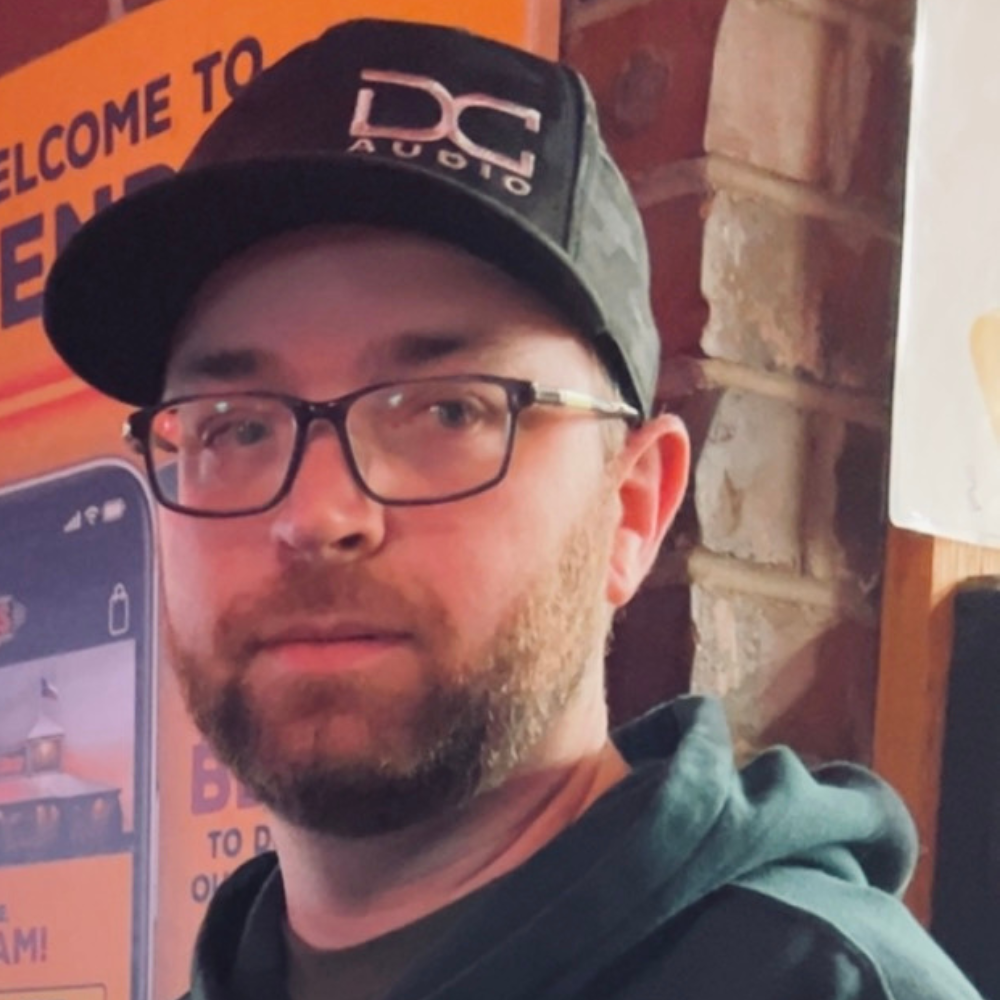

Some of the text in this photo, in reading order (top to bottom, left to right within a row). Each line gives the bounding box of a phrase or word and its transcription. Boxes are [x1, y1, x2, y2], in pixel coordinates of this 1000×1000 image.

[193, 37, 263, 114] TO
[350, 68, 541, 178] DC
[347, 138, 532, 196] AUDIO
[191, 743, 265, 816] B
[207, 827, 242, 859] TO
